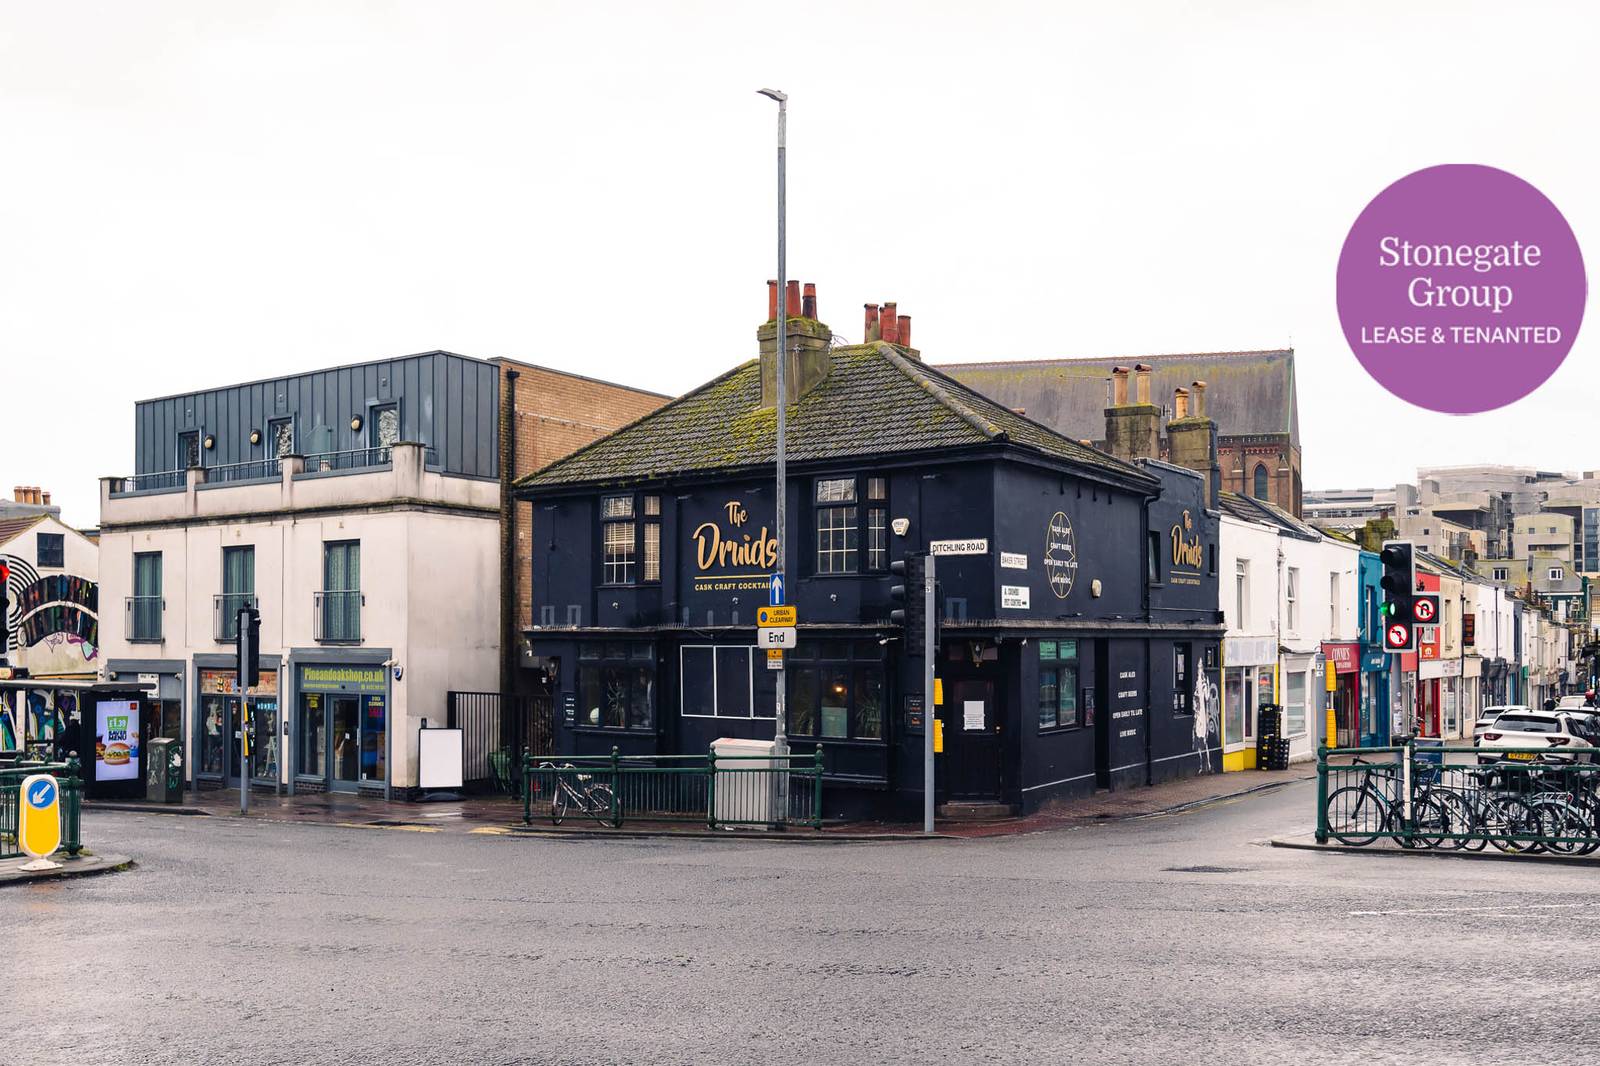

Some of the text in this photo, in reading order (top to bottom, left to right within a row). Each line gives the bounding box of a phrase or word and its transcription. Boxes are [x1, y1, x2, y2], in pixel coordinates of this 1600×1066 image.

[724, 501, 748, 527] The
[692, 522, 778, 570] Druids
[932, 542, 985, 552] DITCHLING ROAD
[1171, 525, 1202, 568] Druids
[768, 632, 784, 642] End
[304, 667, 384, 683] Pineandoakshop.co.uk
